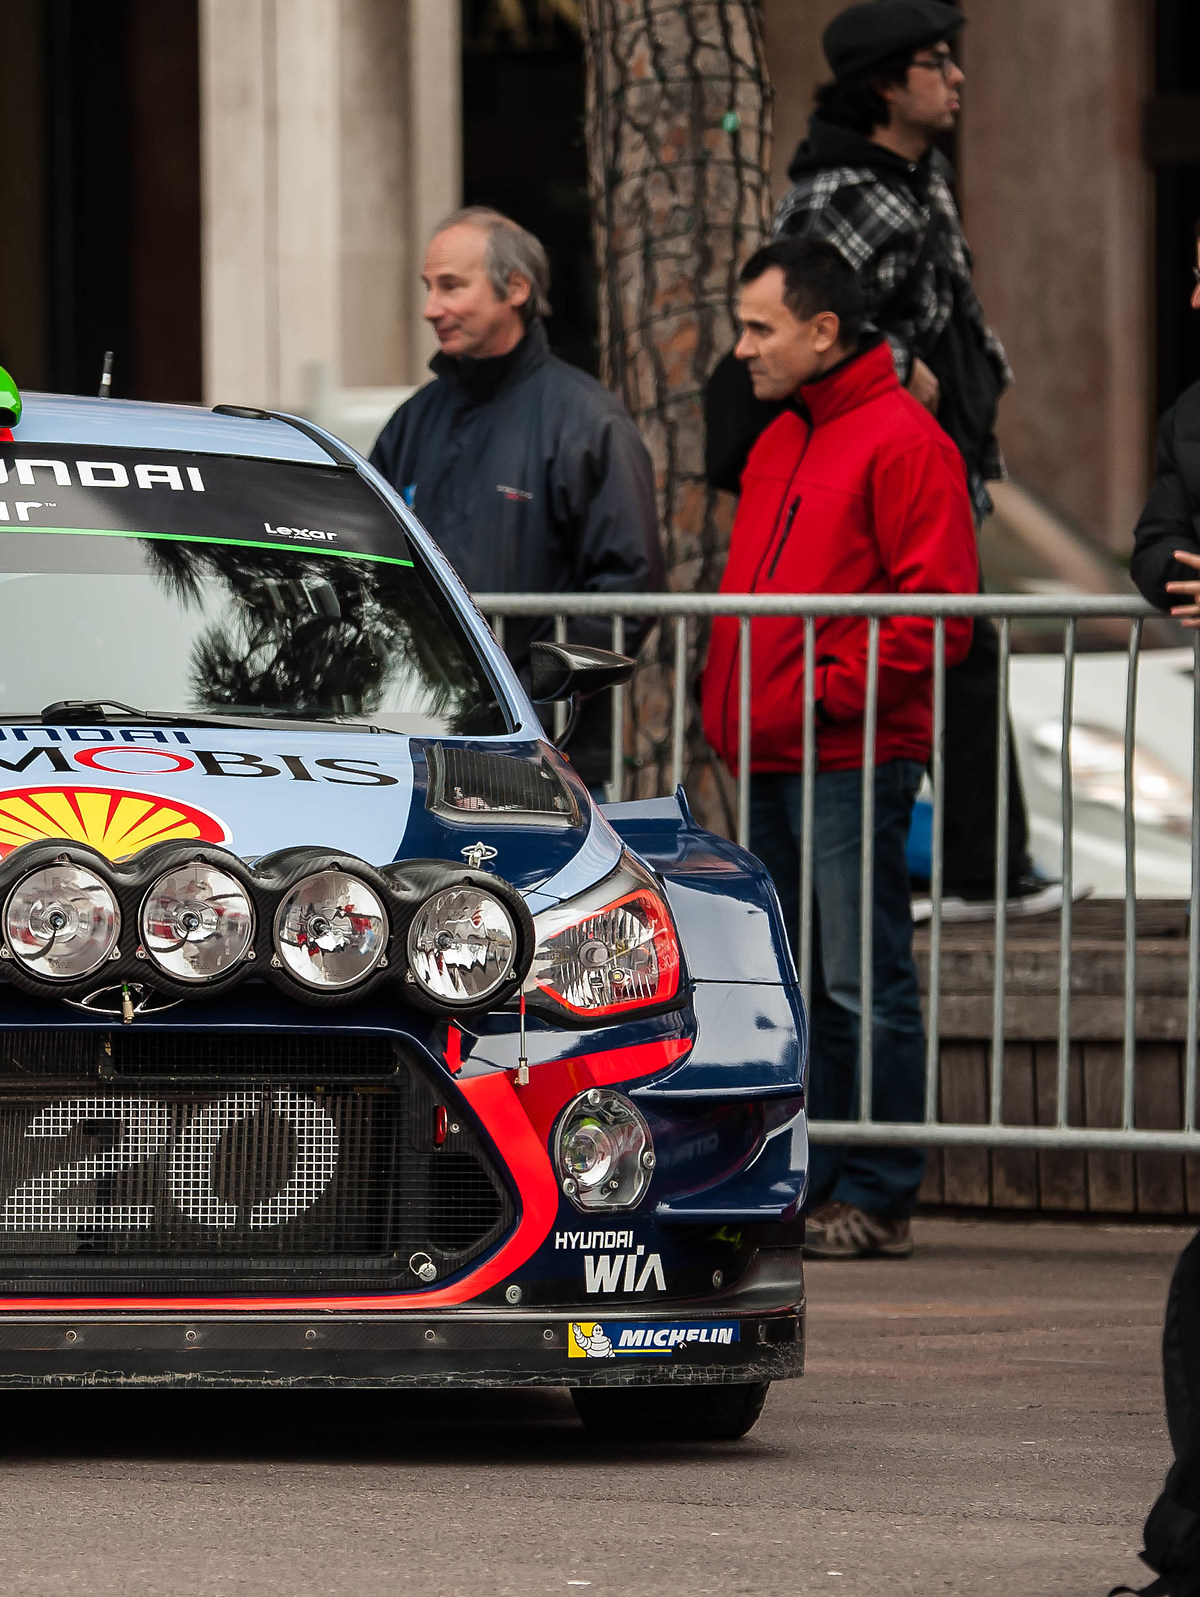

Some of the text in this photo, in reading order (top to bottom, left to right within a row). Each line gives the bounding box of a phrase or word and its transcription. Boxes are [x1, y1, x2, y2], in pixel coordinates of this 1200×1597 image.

[263, 522, 338, 541] Lexar
[555, 1230, 634, 1250] HYUNDAI
[618, 1327, 734, 1348] MICHELIN
